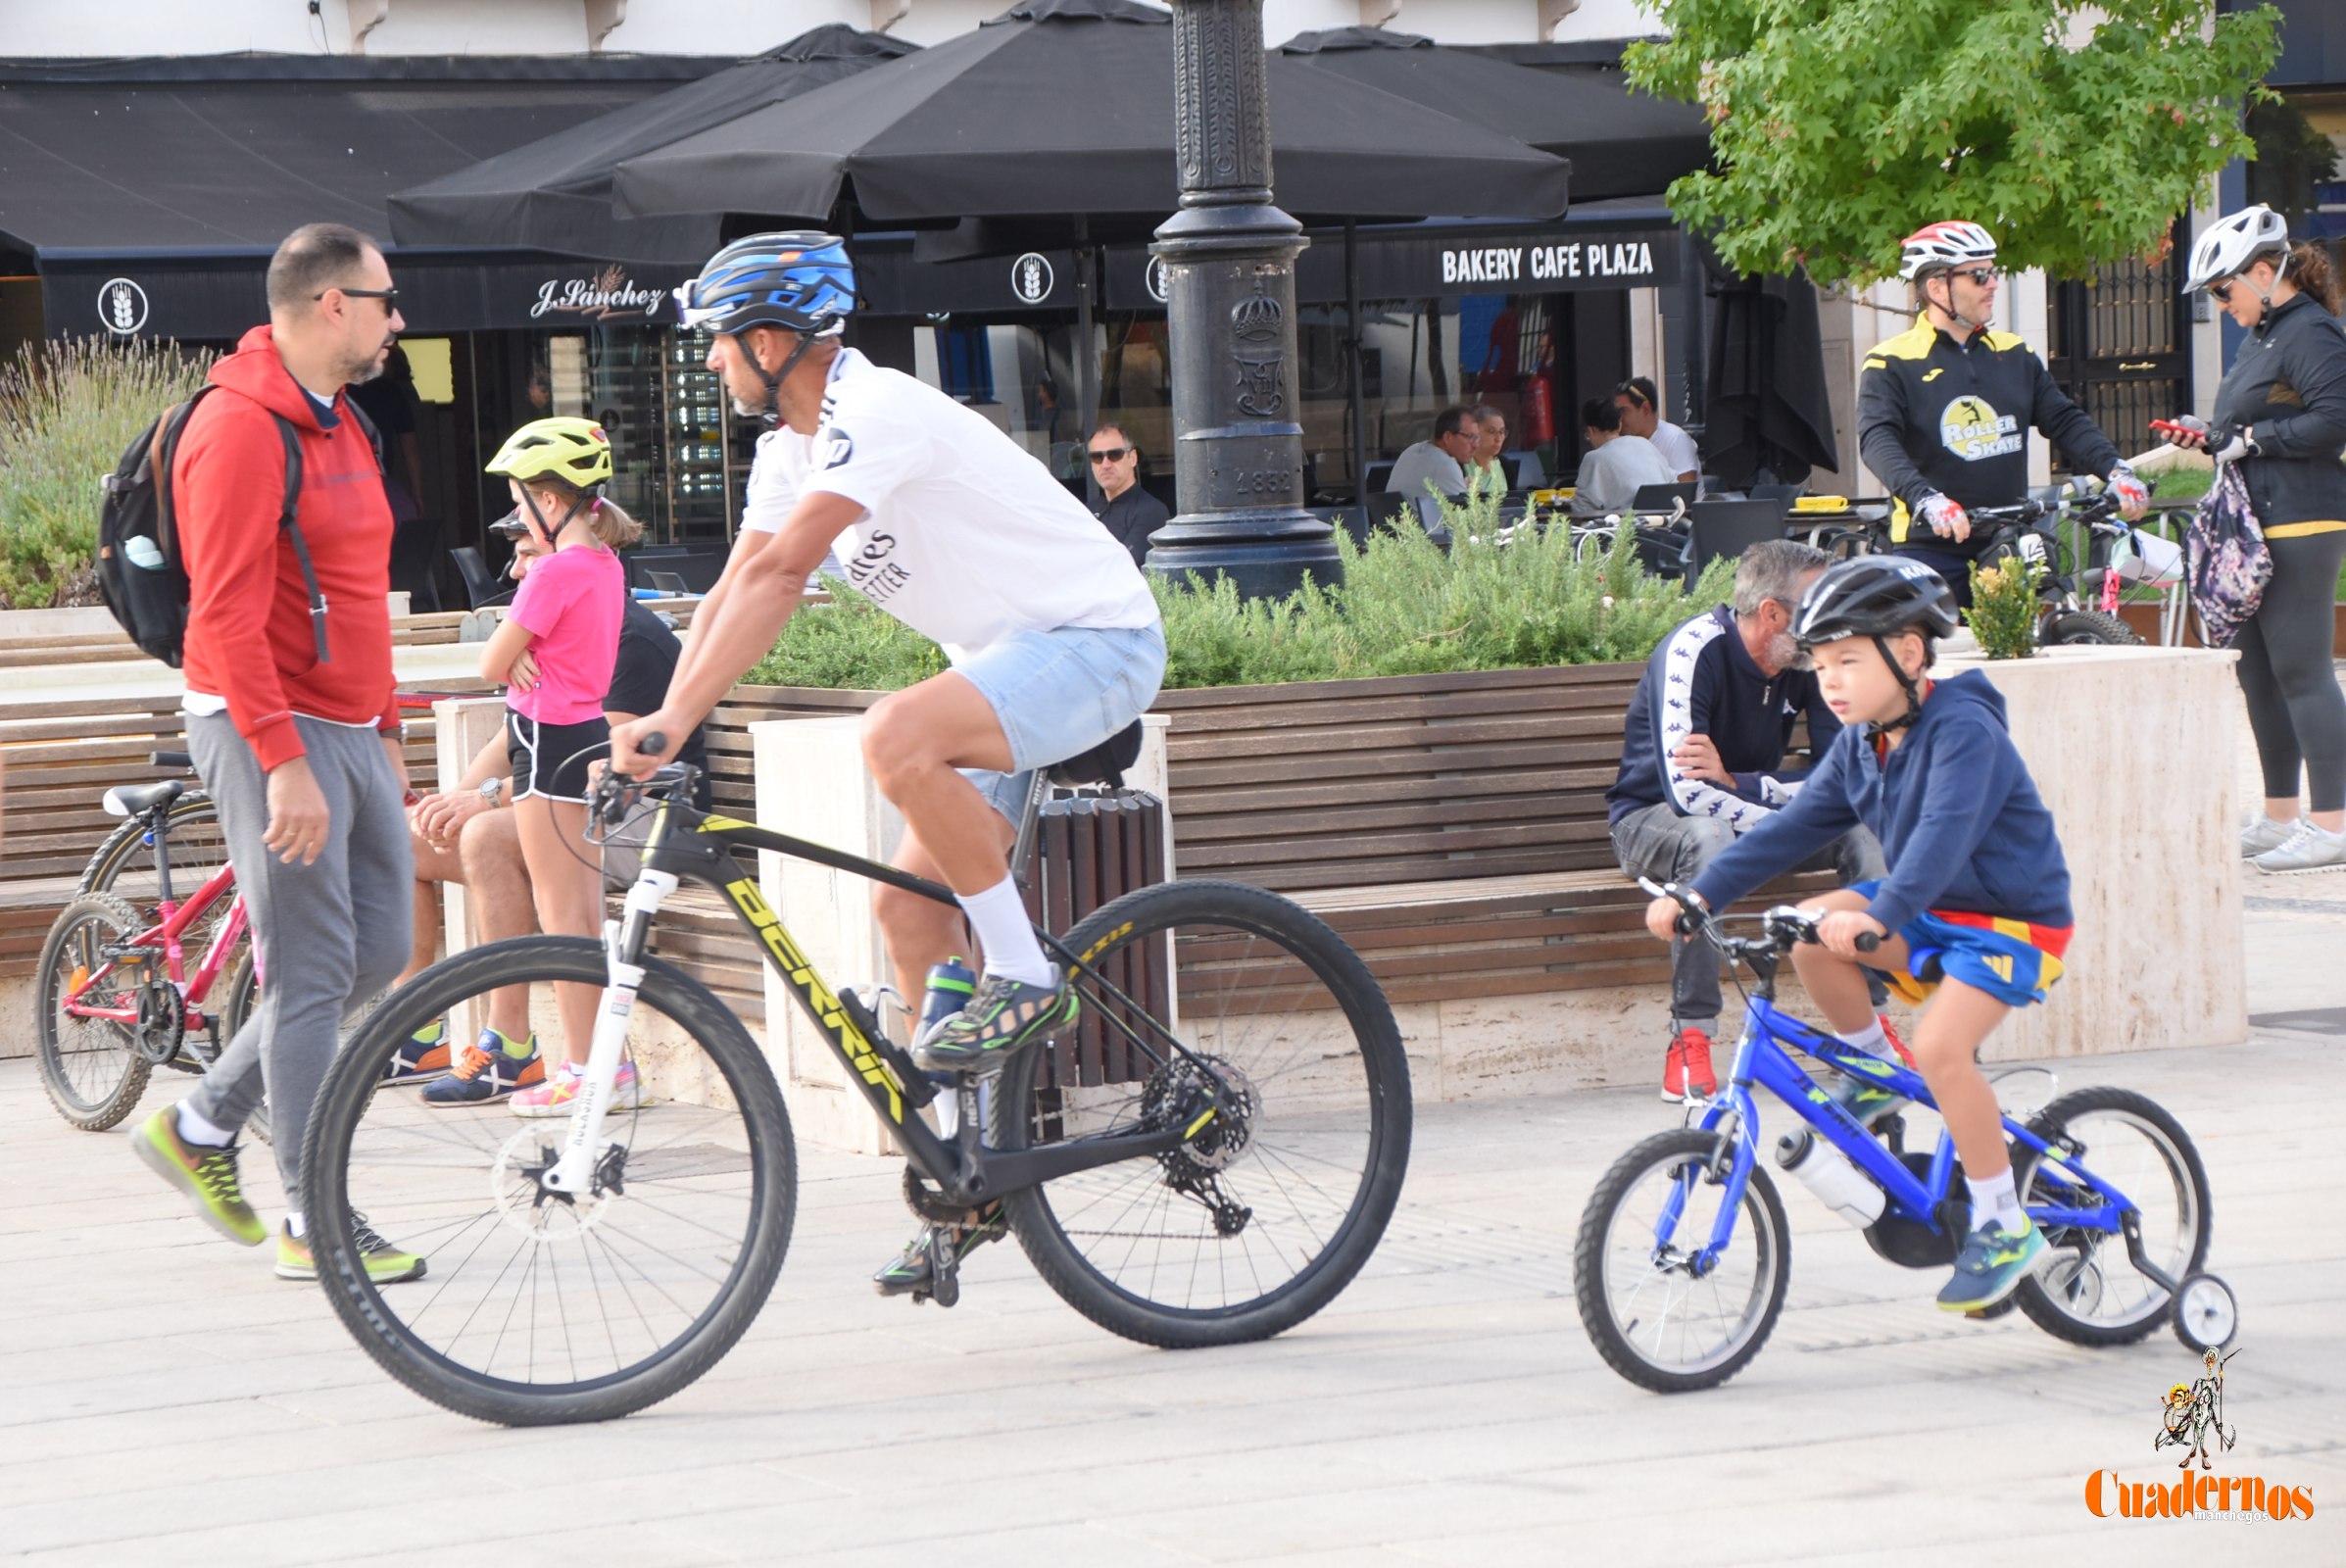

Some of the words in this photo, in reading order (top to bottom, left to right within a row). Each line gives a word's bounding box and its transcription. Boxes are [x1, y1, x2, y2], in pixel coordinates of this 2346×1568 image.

[1442, 247, 1522, 283] BAKERY
[1531, 242, 1582, 279] CAFÉ
[1588, 242, 1653, 276] PLAZA
[1943, 414, 2018, 445] ROLLER
[1966, 433, 2023, 459] SKATE
[1855, 1058, 1883, 1071] JUNIOR
